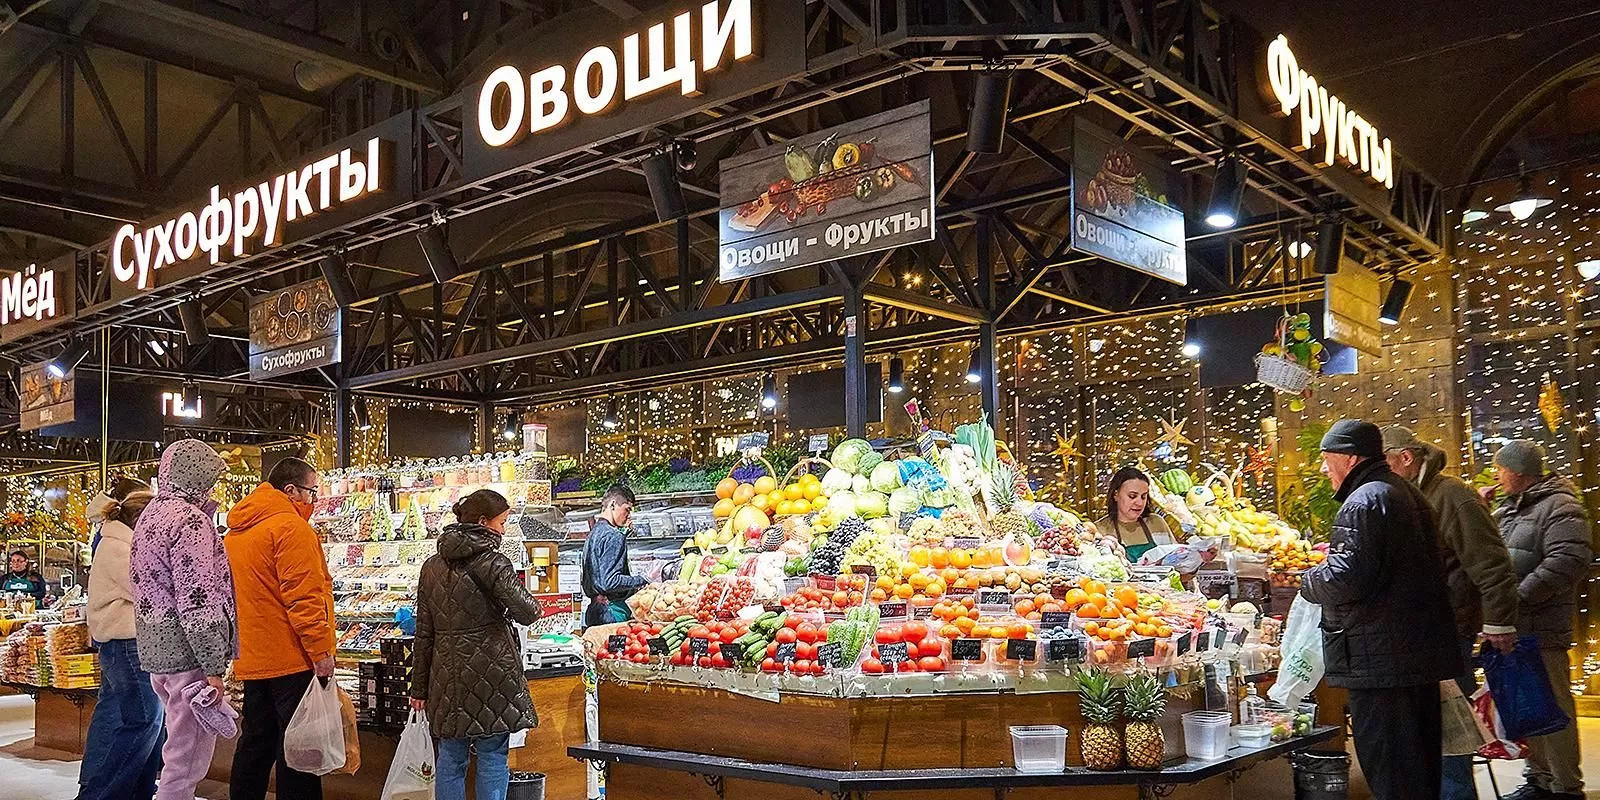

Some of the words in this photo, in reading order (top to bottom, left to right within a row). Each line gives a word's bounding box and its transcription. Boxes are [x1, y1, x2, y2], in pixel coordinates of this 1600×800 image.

[476, 0, 755, 148] Овощи
[1266, 33, 1393, 189] Фрукты
[111, 138, 381, 290] Сухофрукты
[721, 236, 799, 271] Овощи
[824, 207, 929, 250] Фрукты
[0, 263, 56, 325] Мёд
[261, 345, 326, 371] Сухофрукты
[225, 472, 262, 484] Фрукты
